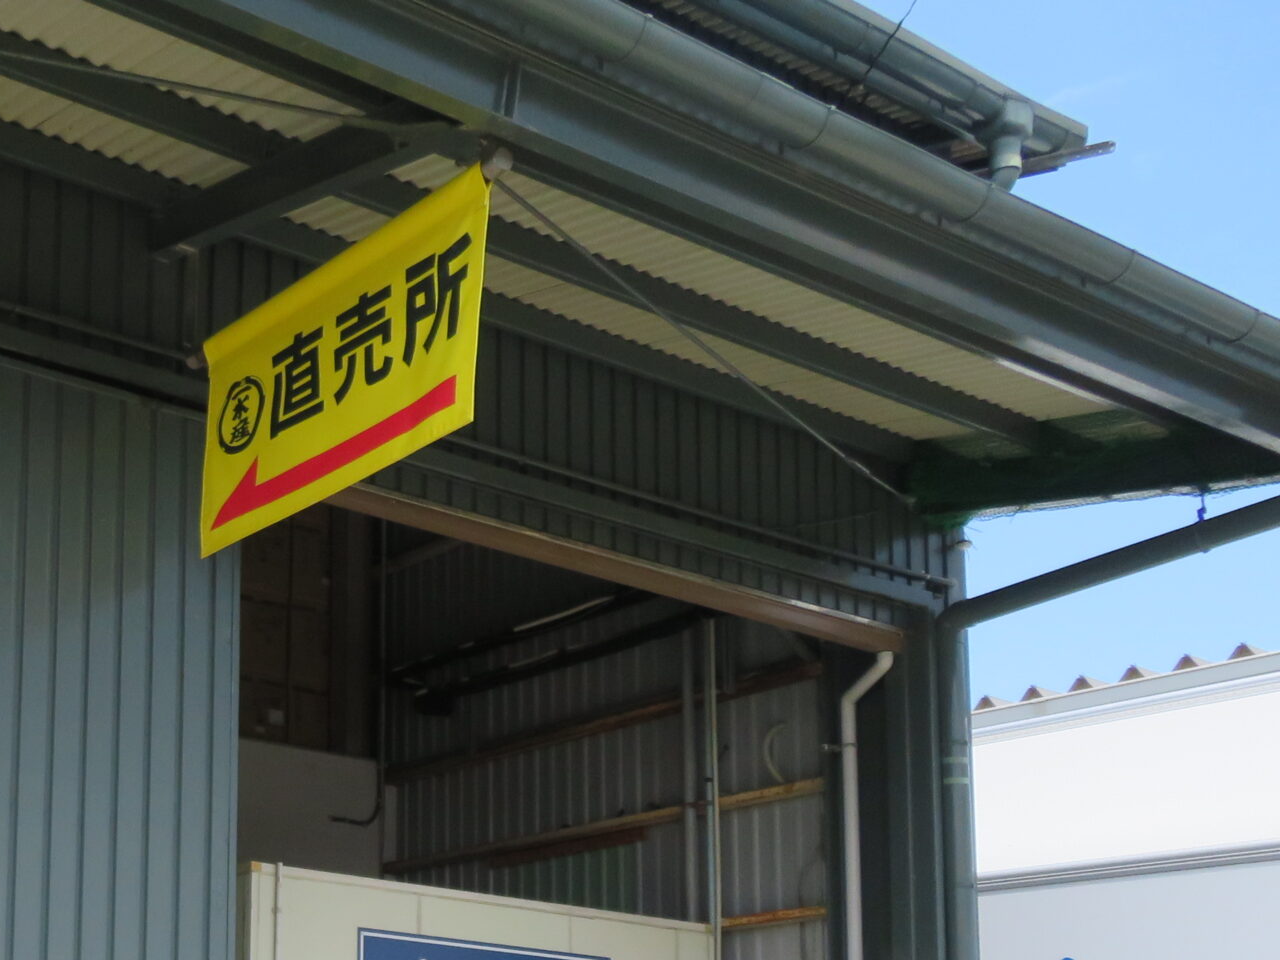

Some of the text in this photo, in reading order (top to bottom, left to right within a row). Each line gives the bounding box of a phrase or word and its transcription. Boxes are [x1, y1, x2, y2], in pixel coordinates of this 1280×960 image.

[270, 232, 472, 440] 直売所
[230, 384, 253, 445] 一水産
